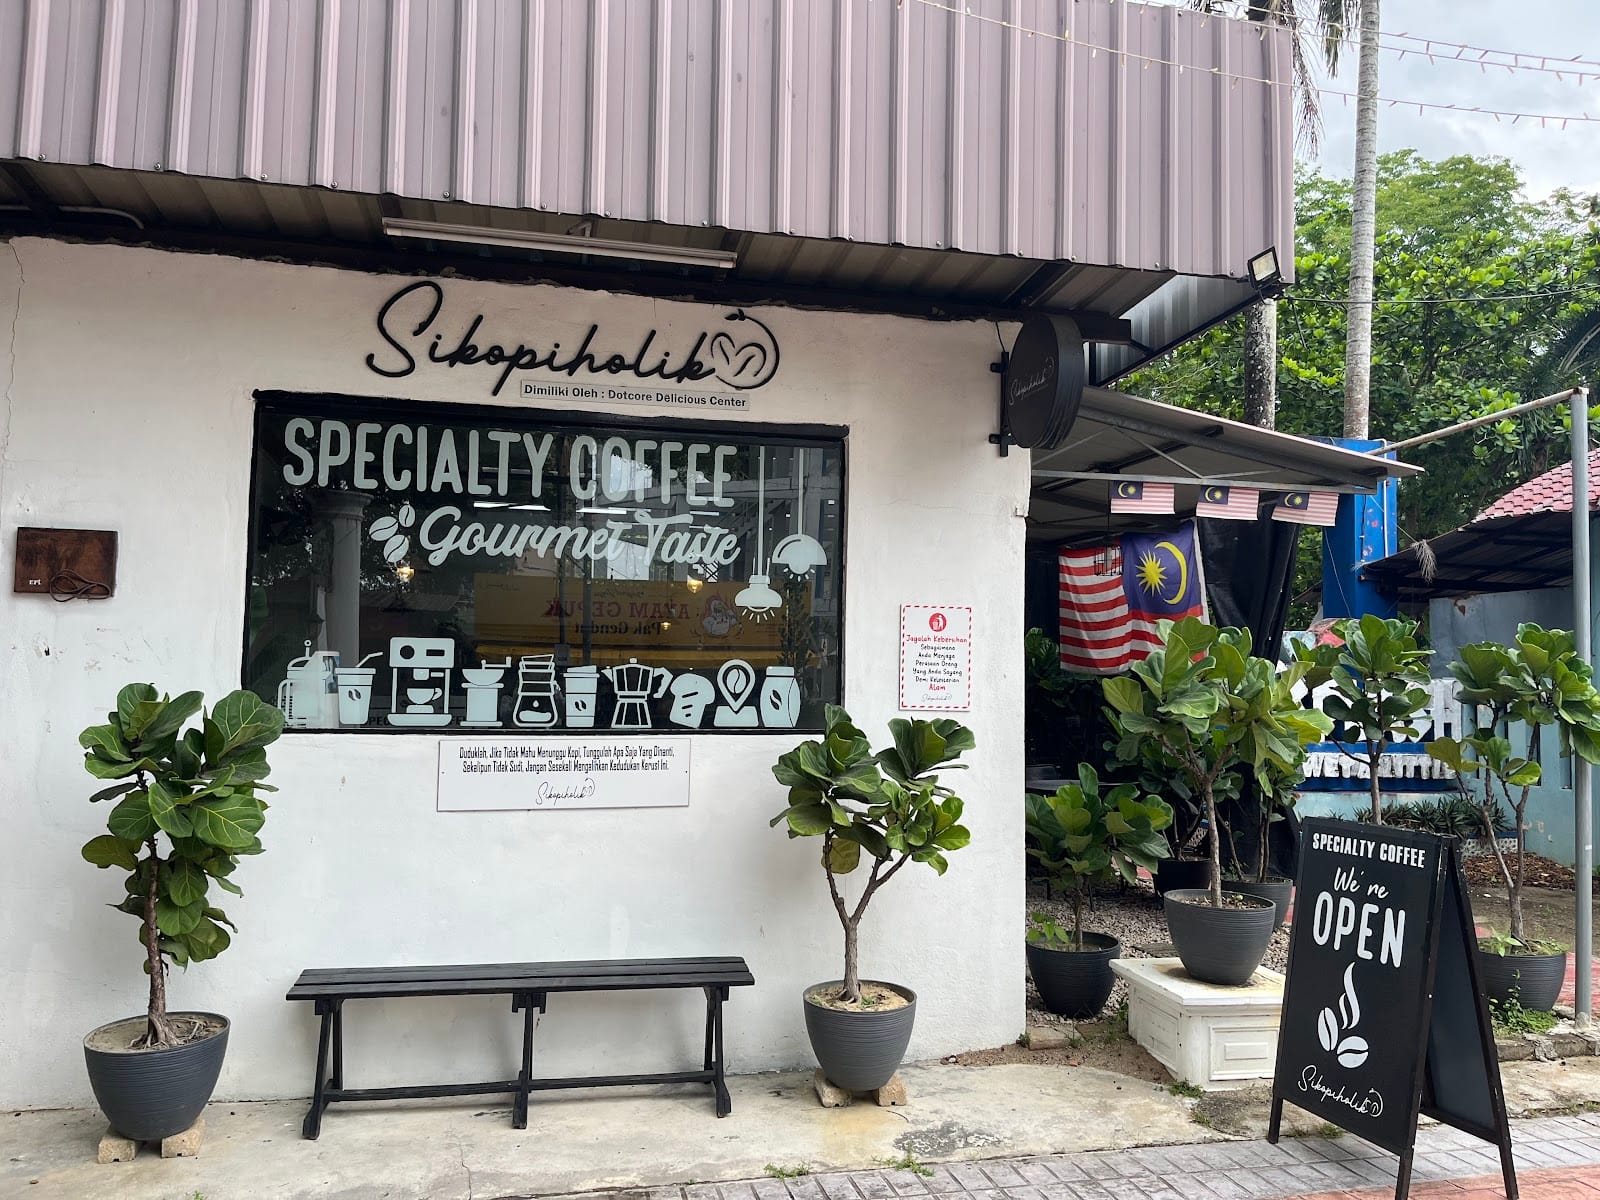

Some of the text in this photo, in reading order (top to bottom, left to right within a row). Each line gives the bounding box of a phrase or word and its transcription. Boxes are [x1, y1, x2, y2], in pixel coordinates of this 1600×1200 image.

[365, 281, 716, 396] Sikopiholik
[524, 384, 569, 397] Dimiliki
[572, 387, 598, 398] Oleh
[608, 389, 652, 402] Dotcore
[656, 392, 707, 405] Delicious
[709, 396, 747, 408] Center
[283, 417, 738, 508] SPECIALTY COFFEE
[419, 505, 741, 567] Gourmet Taste
[459, 745, 675, 760] Duduklah, Jika Tidak Mahu Menunggu Kopi, Tunggulah Apa Saja Yang Dinanti,
[463, 761, 491, 774] Sekalipun
[493, 760, 508, 773] Tidak
[526, 760, 547, 774] Jangan
[548, 760, 572, 772] Sesekali
[573, 760, 609, 774] Mengalihkan
[609, 759, 640, 771] Kedudukan
[641, 759, 660, 771] Kerusi
[660, 759, 670, 771] Ini.
[1312, 832, 1426, 869] SPECIALTY COFFEE
[1312, 891, 1406, 968] OPEN
[1297, 1064, 1369, 1114] Sikopiholik
